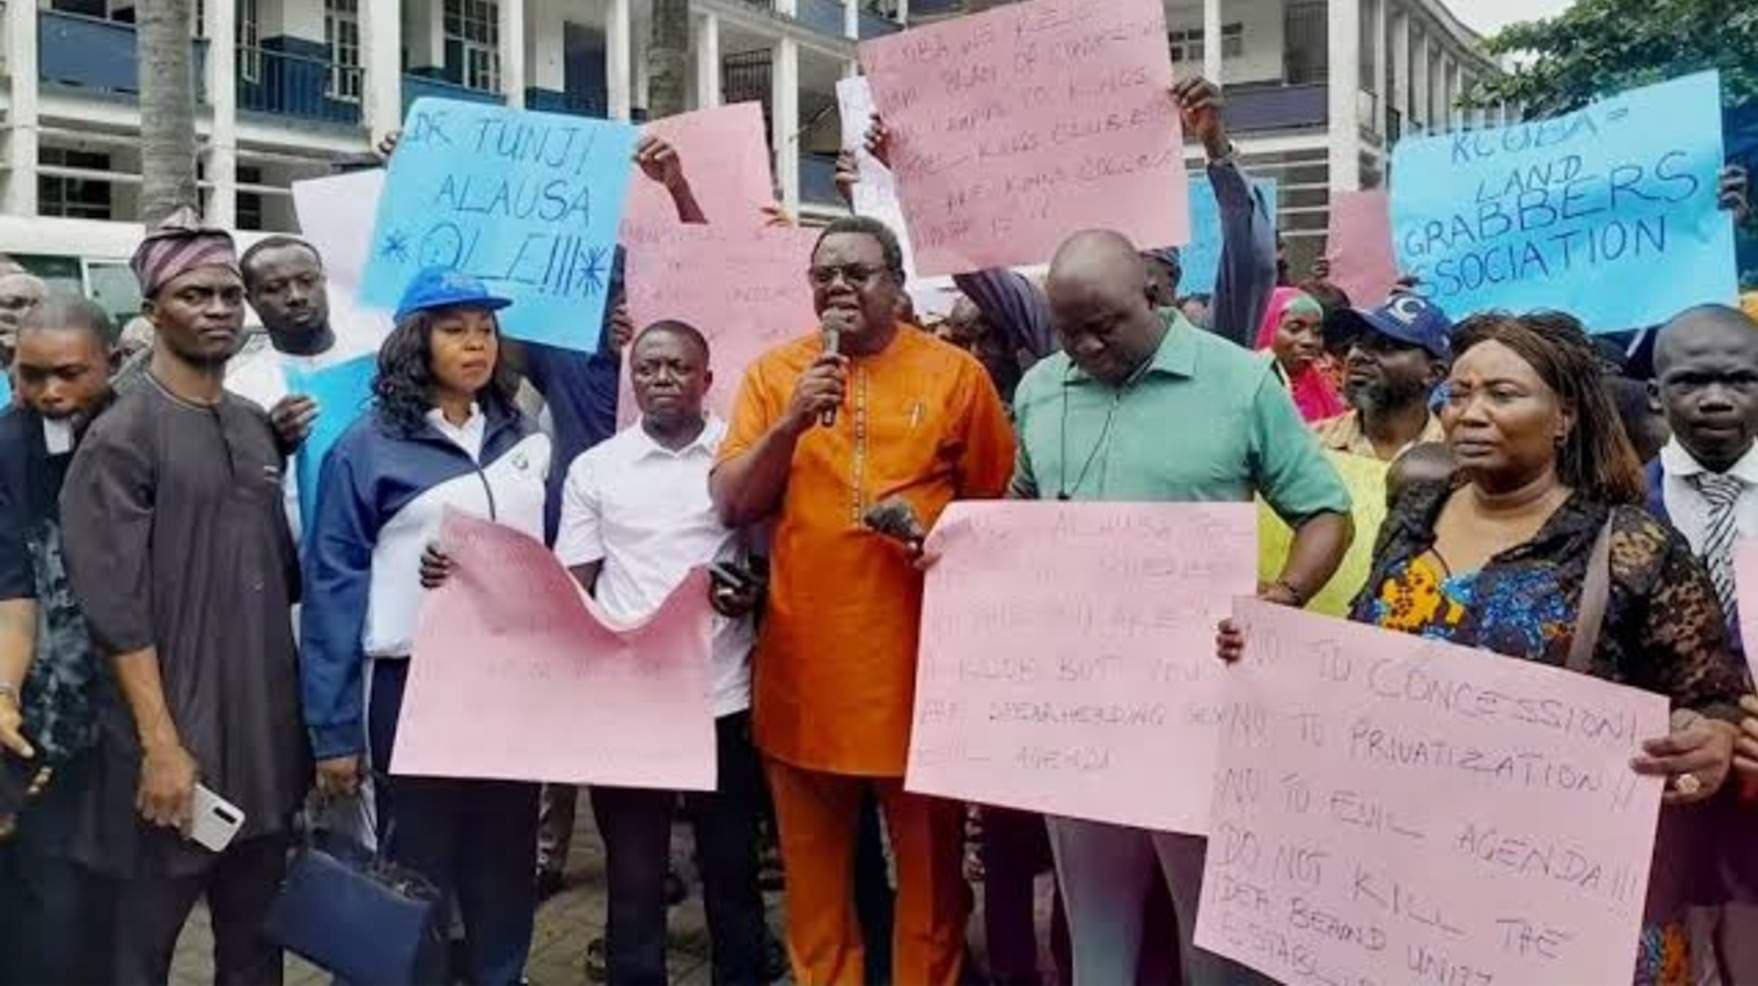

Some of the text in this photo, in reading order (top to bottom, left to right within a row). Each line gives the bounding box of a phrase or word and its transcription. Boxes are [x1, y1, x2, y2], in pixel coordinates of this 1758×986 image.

[436, 174, 592, 227] ALAUSA
[1404, 151, 1699, 257] GRABBERS
[1402, 216, 1665, 300] SSOCIATION
